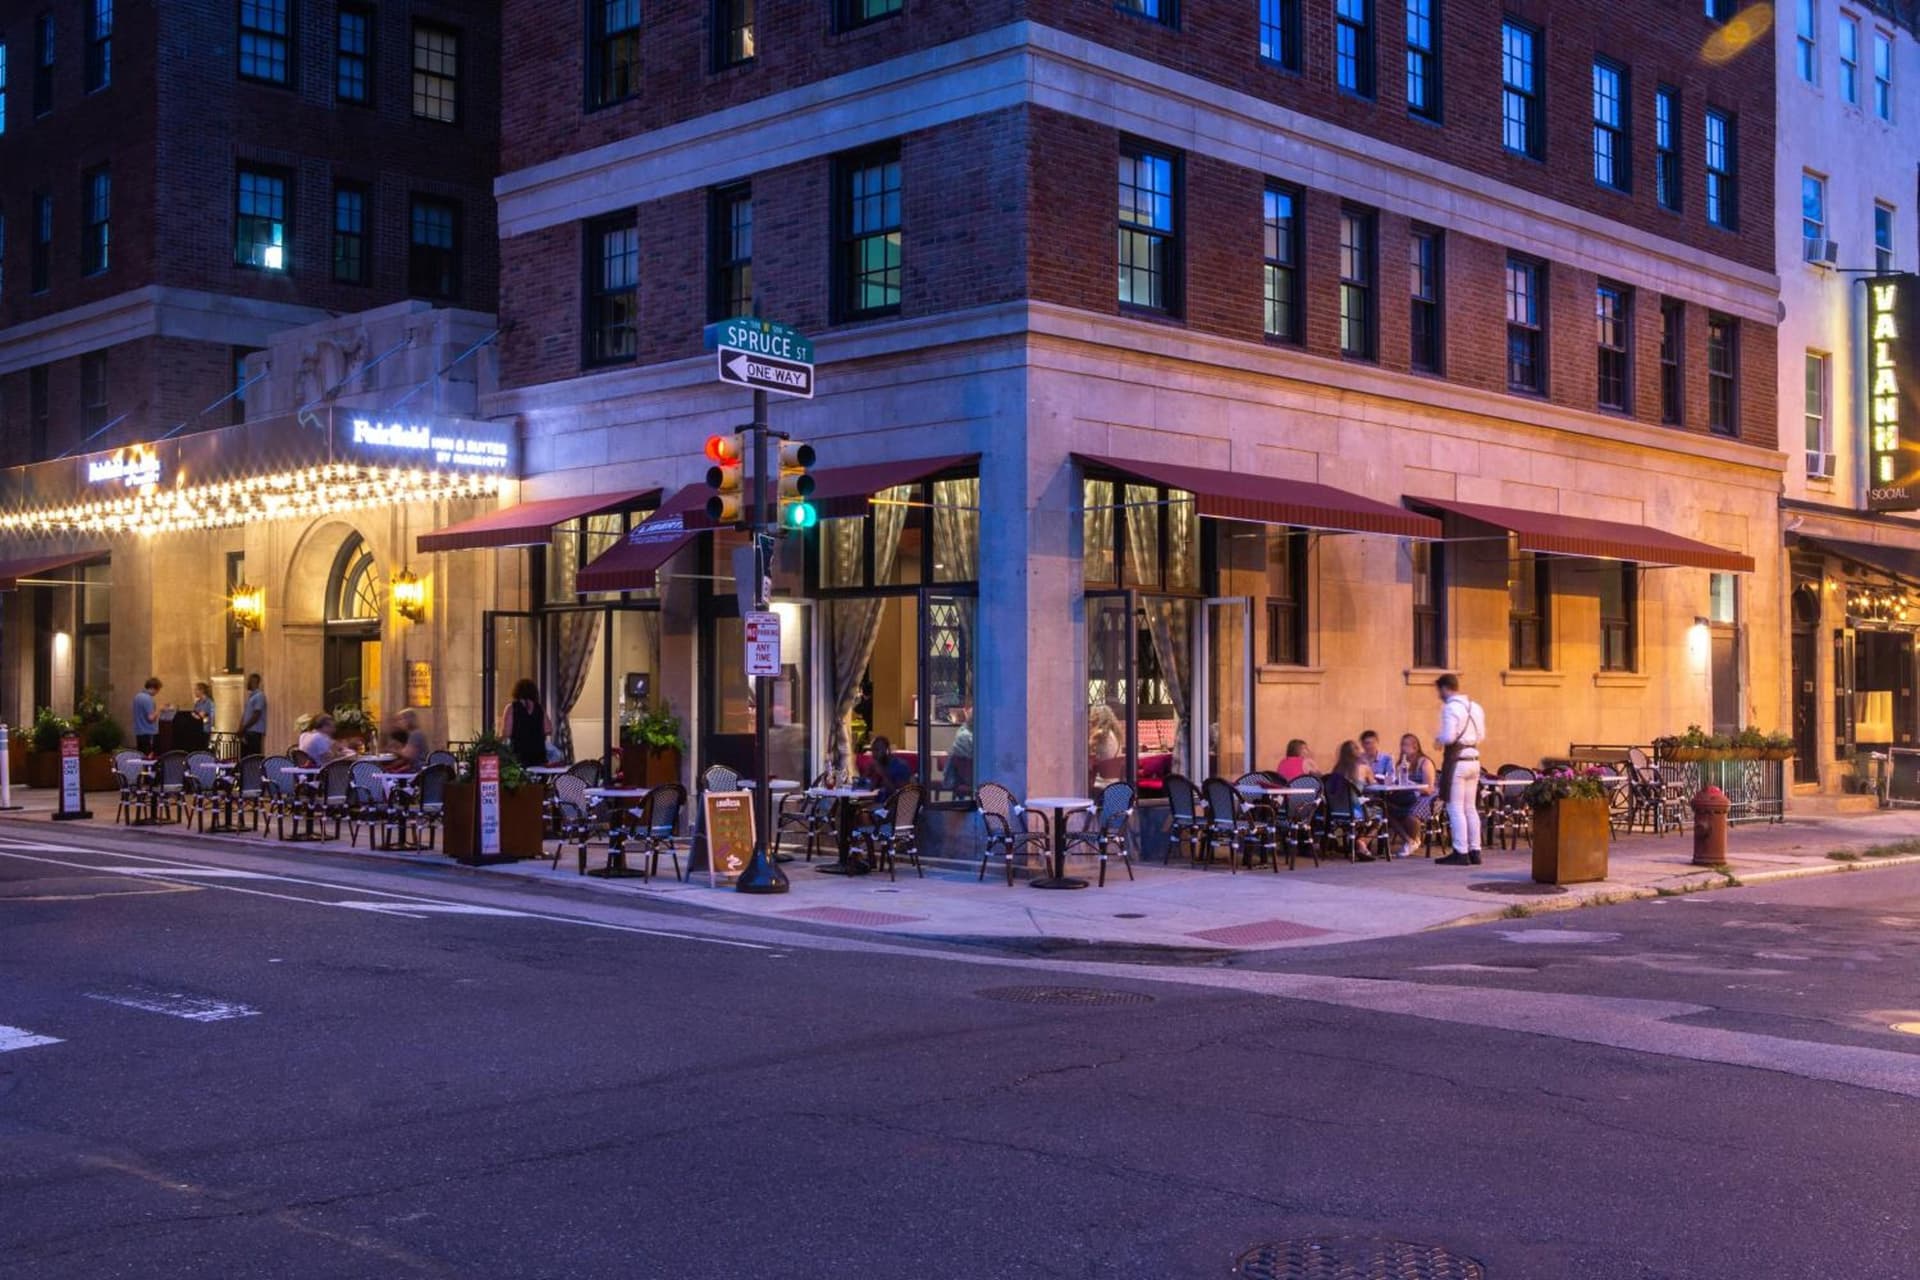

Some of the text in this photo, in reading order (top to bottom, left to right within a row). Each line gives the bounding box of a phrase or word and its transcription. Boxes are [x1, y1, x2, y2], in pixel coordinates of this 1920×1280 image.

[728, 326, 807, 361] SPRUCE ST
[747, 363, 802, 385] ONE WAY
[1873, 284, 1899, 482] VALANNI
[1871, 488, 1909, 500] SOCIAL
[756, 653, 771, 662] TIME
